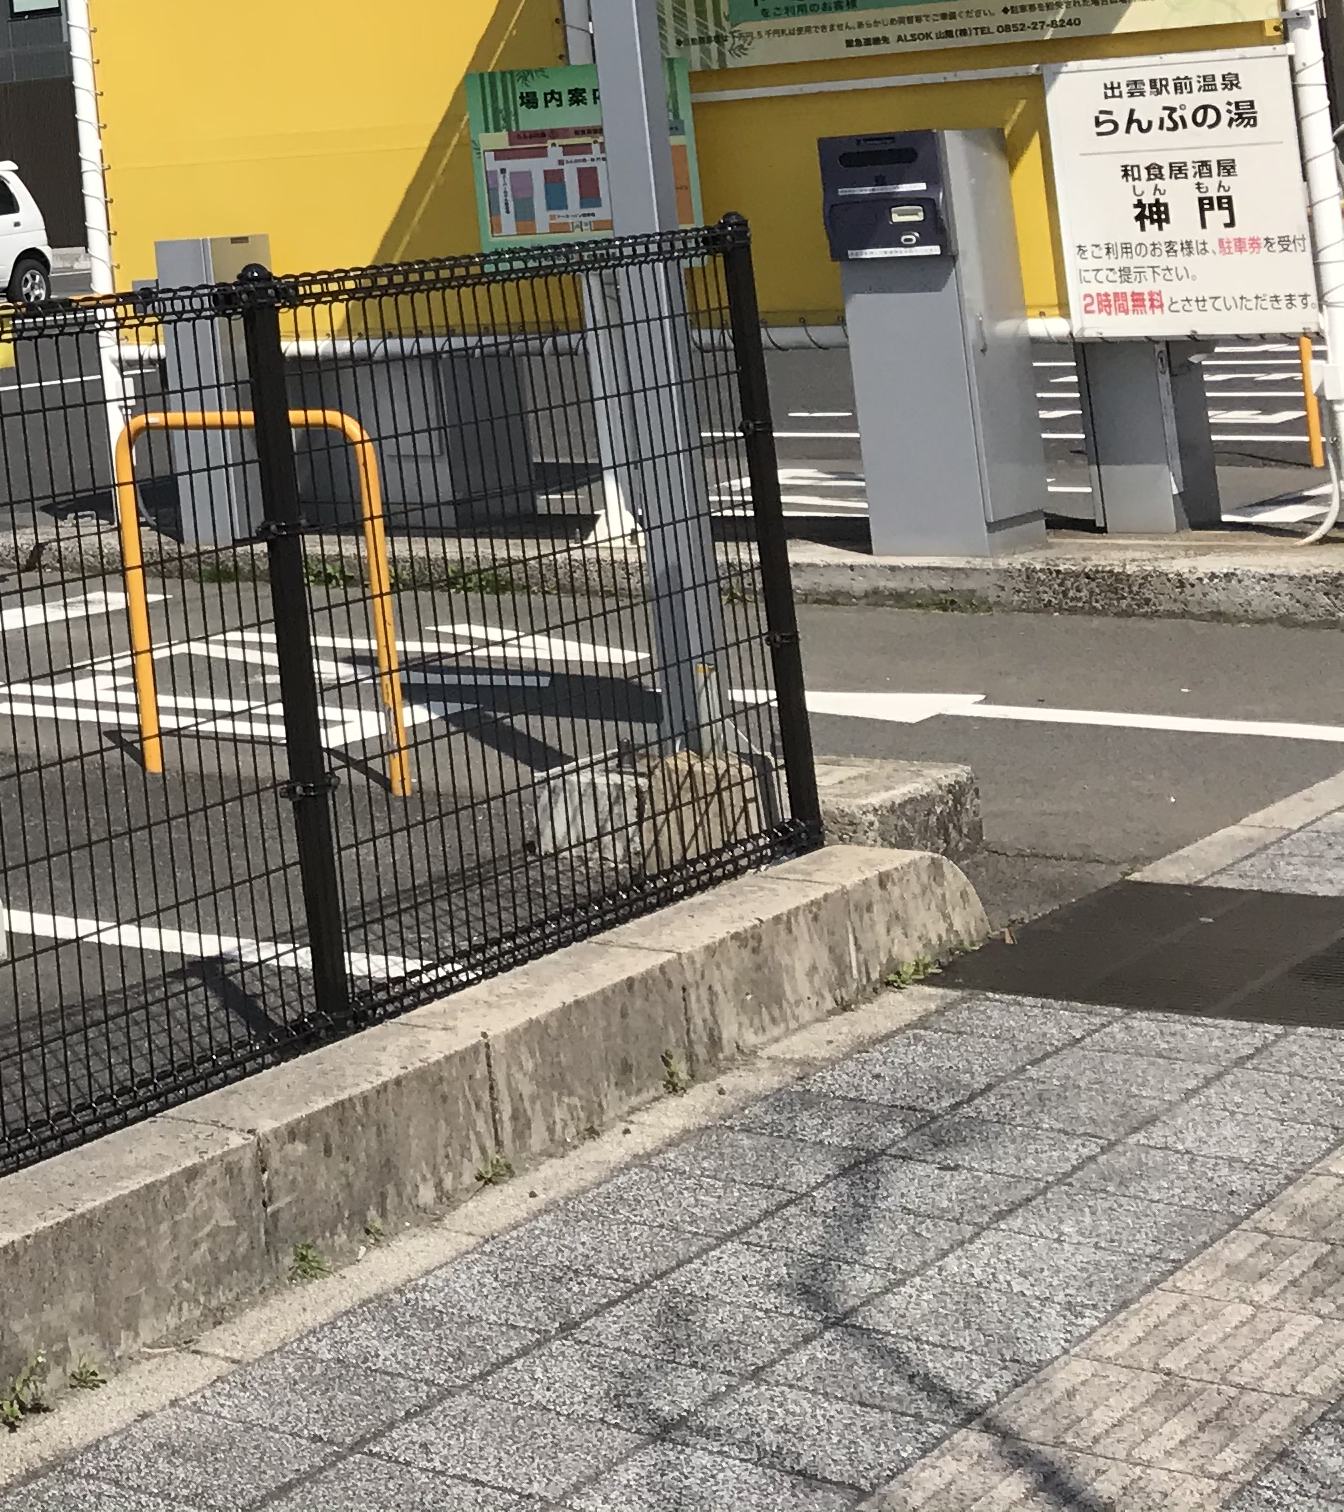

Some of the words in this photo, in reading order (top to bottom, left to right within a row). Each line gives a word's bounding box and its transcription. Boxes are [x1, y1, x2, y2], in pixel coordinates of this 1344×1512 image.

[896, 31, 933, 44] ALSOK
[1103, 71, 1242, 100] 出雲駅前温泉
[1094, 100, 1258, 137] らんぷの湯
[1121, 159, 1238, 183] 和食居酒屋
[1079, 265, 1197, 285] にてご提示下さい。
